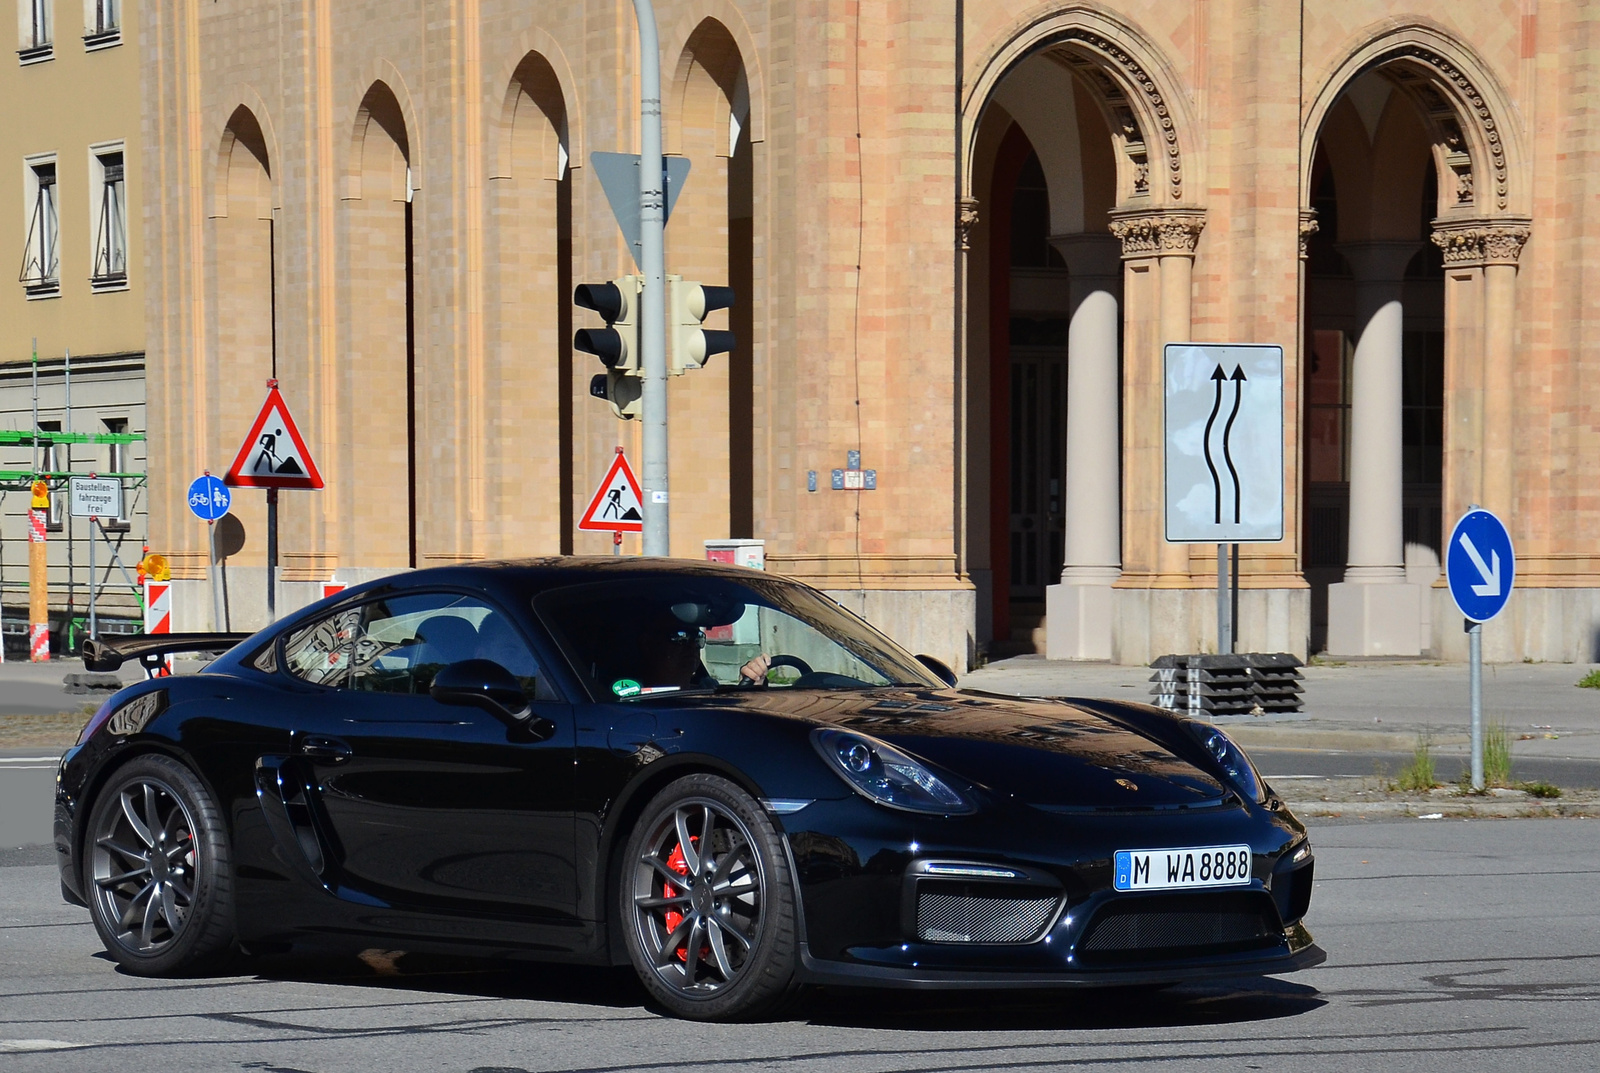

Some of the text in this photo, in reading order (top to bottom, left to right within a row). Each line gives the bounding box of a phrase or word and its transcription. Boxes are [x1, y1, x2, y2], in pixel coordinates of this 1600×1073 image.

[75, 482, 114, 491] Baustellen-
[79, 493, 111, 504] fahrzeuge
[88, 504, 103, 513] frei
[1159, 669, 1175, 681] W
[1161, 682, 1200, 694] W H
[1159, 695, 1201, 708] W H
[1133, 855, 1150, 884] M
[1120, 874, 1126, 884] D
